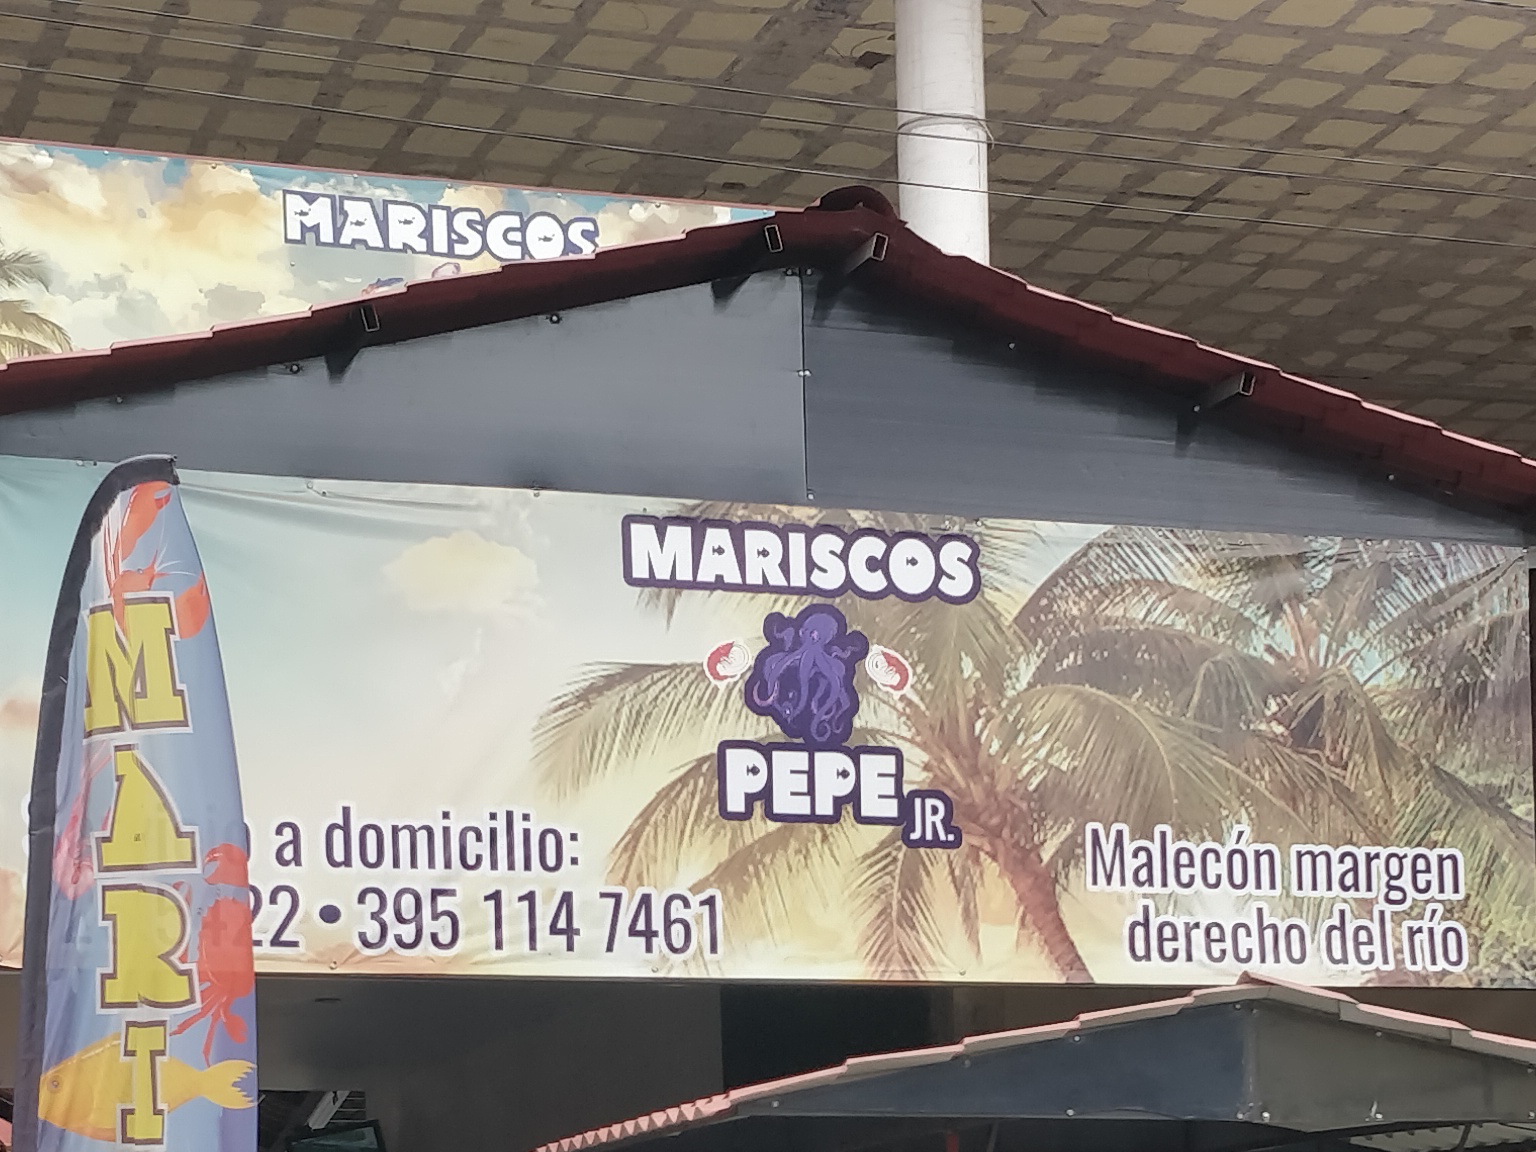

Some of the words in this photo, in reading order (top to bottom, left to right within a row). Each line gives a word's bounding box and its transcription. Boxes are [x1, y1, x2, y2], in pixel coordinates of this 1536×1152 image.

[282, 190, 599, 260] MARISCOS
[626, 518, 977, 600] MARISCOS
[722, 745, 901, 819] PEPE
[910, 797, 955, 842] JR.
[275, 821, 302, 867] a
[325, 806, 580, 872] domicilio:
[1090, 828, 1278, 890] Malecón
[1296, 847, 1460, 905] margen
[358, 887, 460, 949] 395
[484, 889, 581, 951] 114
[599, 891, 720, 954] 7461
[1128, 905, 1307, 964] derecho
[1325, 909, 1390, 966] del
[1406, 908, 1464, 967] río
